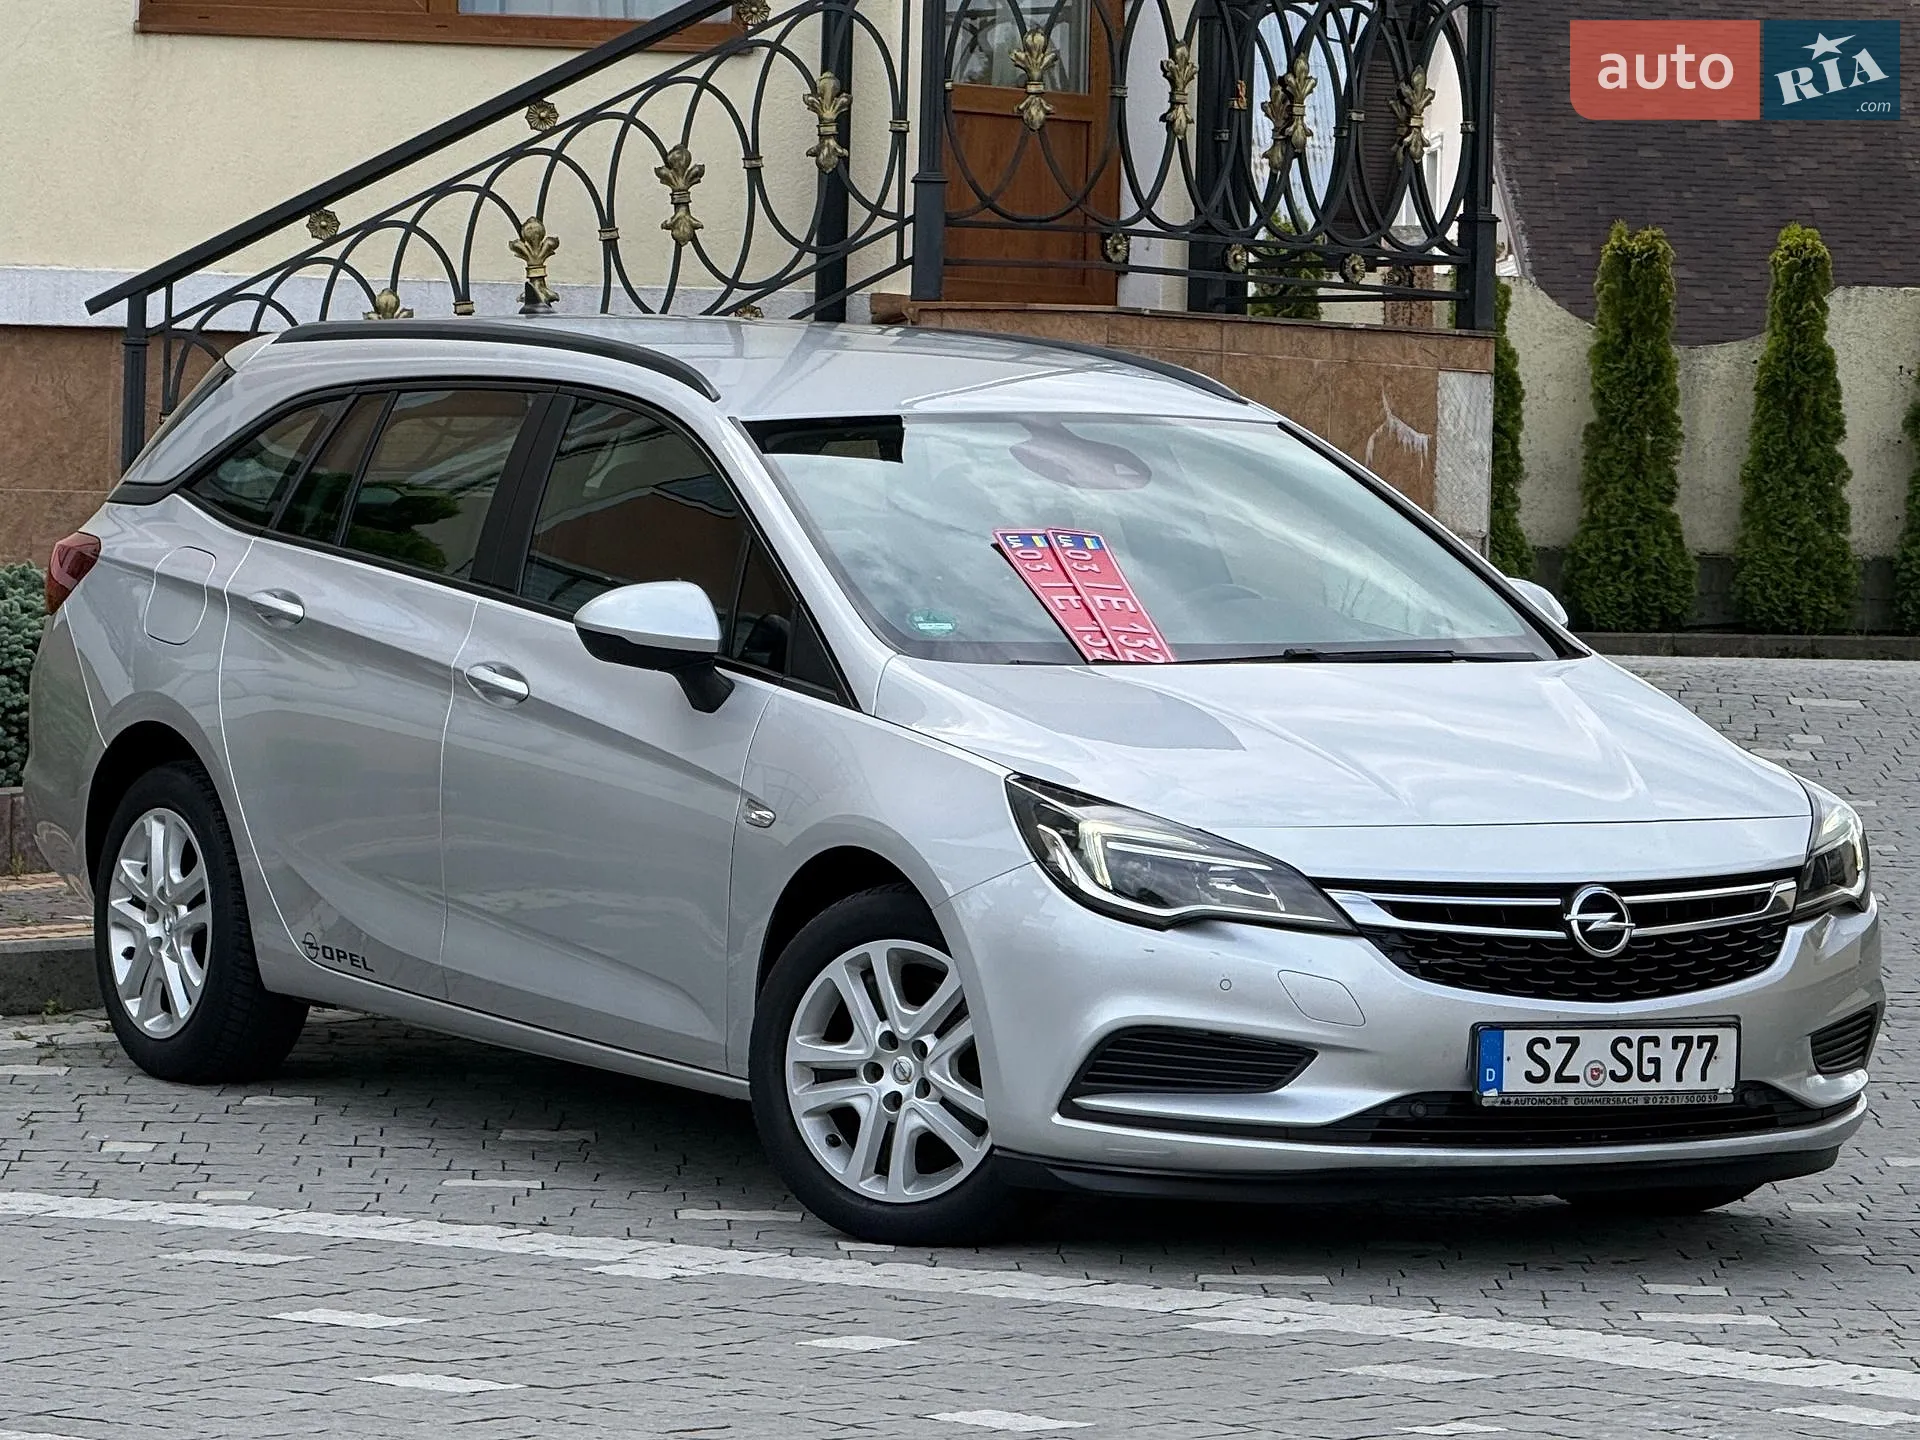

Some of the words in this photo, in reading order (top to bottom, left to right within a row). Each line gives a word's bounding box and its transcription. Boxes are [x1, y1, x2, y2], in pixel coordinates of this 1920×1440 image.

[1057, 535, 1074, 548] UA
[1006, 535, 1024, 548] UA
[1016, 550, 1053, 572] 03
[1064, 550, 1101, 573] 03
[321, 945, 375, 973] OPEL
[1524, 1036, 1581, 1084] SZ
[1486, 1068, 1496, 1082] D
[1514, 1096, 1569, 1106] AUTOMOBILE
[1573, 1096, 1639, 1106] GUMMERSBACH
